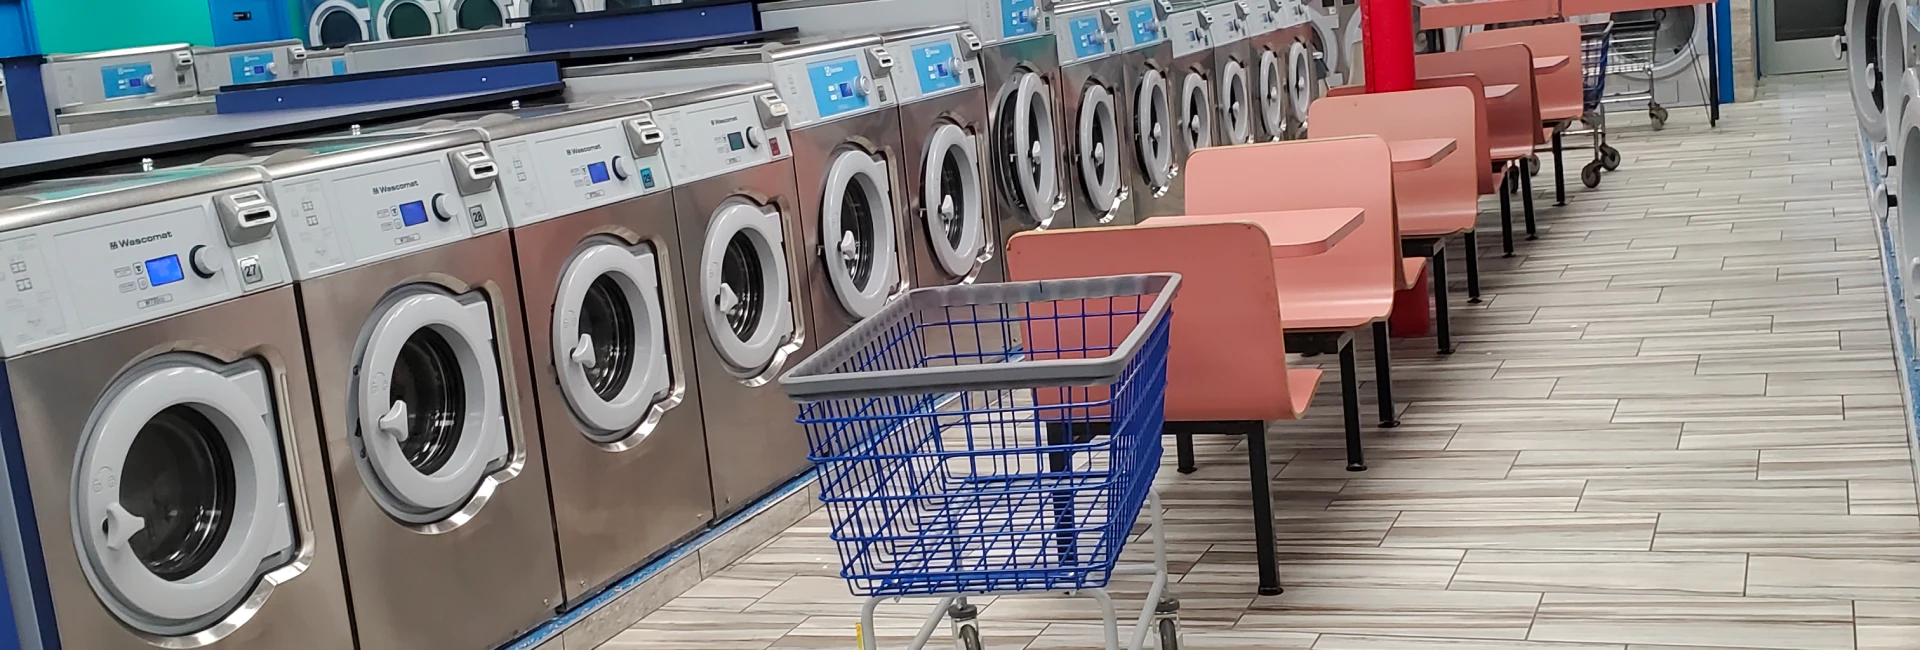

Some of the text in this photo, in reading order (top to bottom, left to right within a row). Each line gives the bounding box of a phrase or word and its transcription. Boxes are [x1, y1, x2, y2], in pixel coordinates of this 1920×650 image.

[379, 180, 419, 194] Wascomat
[472, 211, 483, 222] 28
[118, 231, 173, 248] Wascomat
[244, 264, 257, 278] 27
